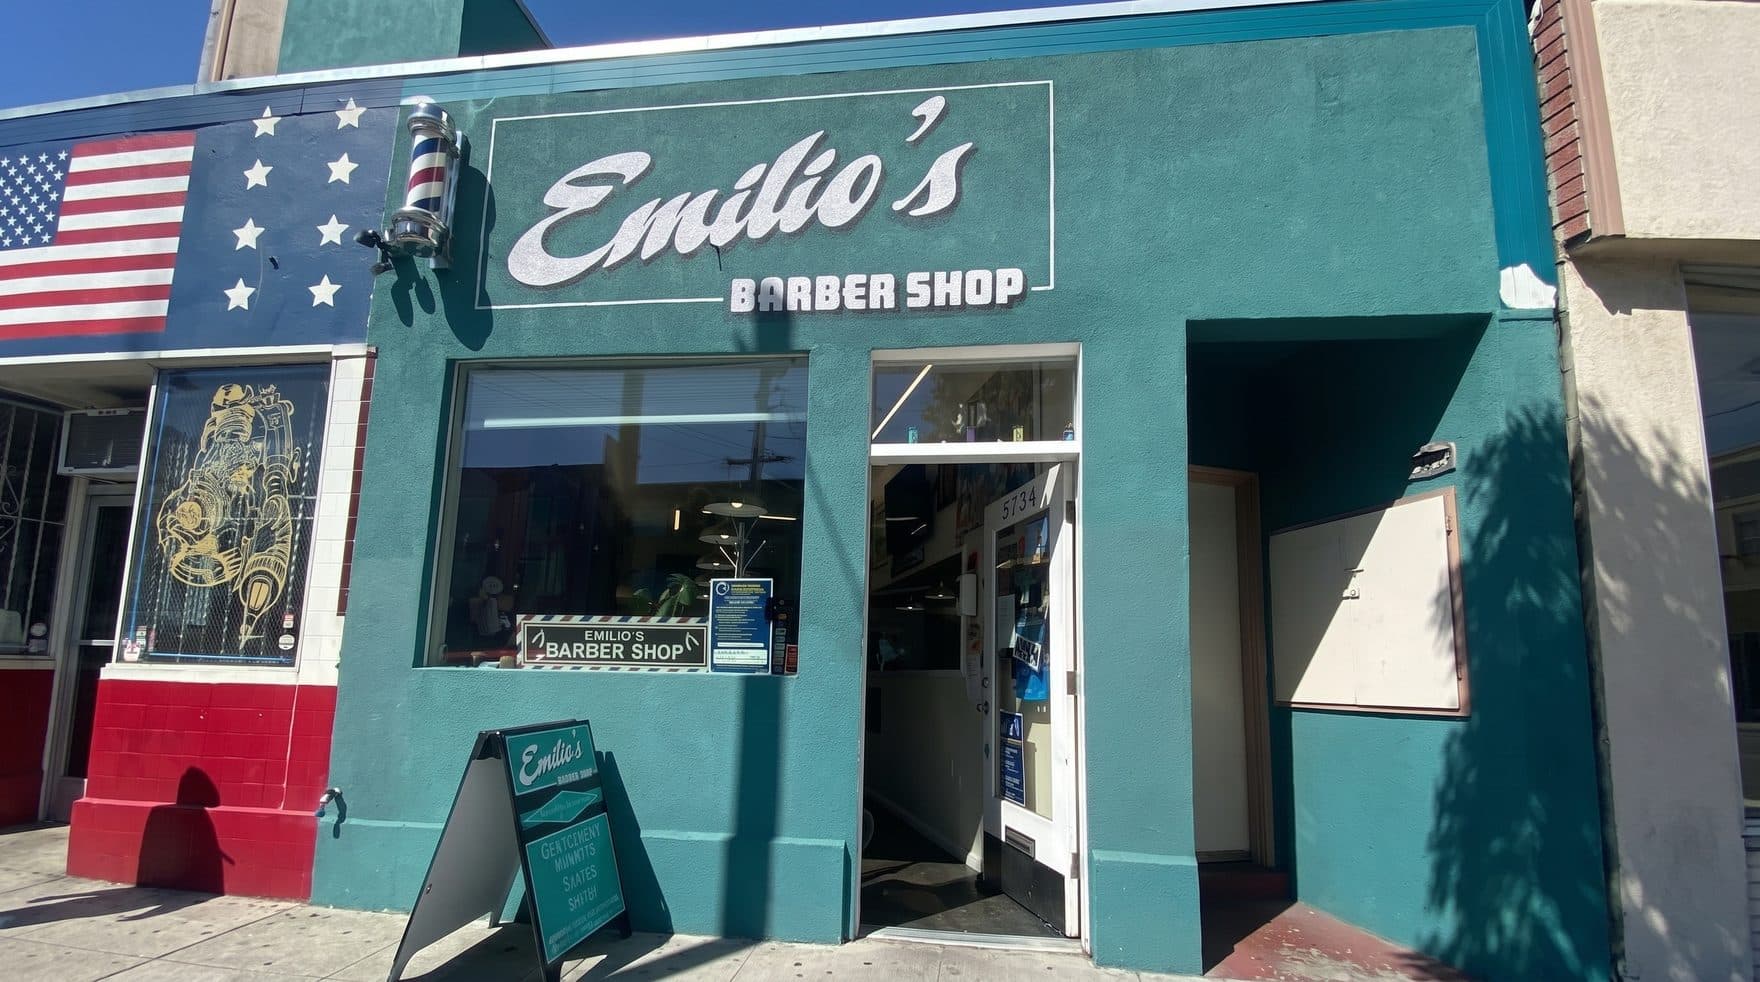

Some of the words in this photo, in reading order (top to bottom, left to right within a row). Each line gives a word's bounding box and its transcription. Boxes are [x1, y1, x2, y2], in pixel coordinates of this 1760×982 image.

[507, 95, 973, 286] Emilio's
[730, 273, 896, 313] BARBER
[906, 268, 1024, 308] SHOP
[1002, 485, 1036, 520] 5734
[546, 642, 625, 659] BARBER
[631, 643, 684, 660] SHOP
[584, 630, 645, 642] EMILIO'S
[519, 729, 583, 786] Emilio's
